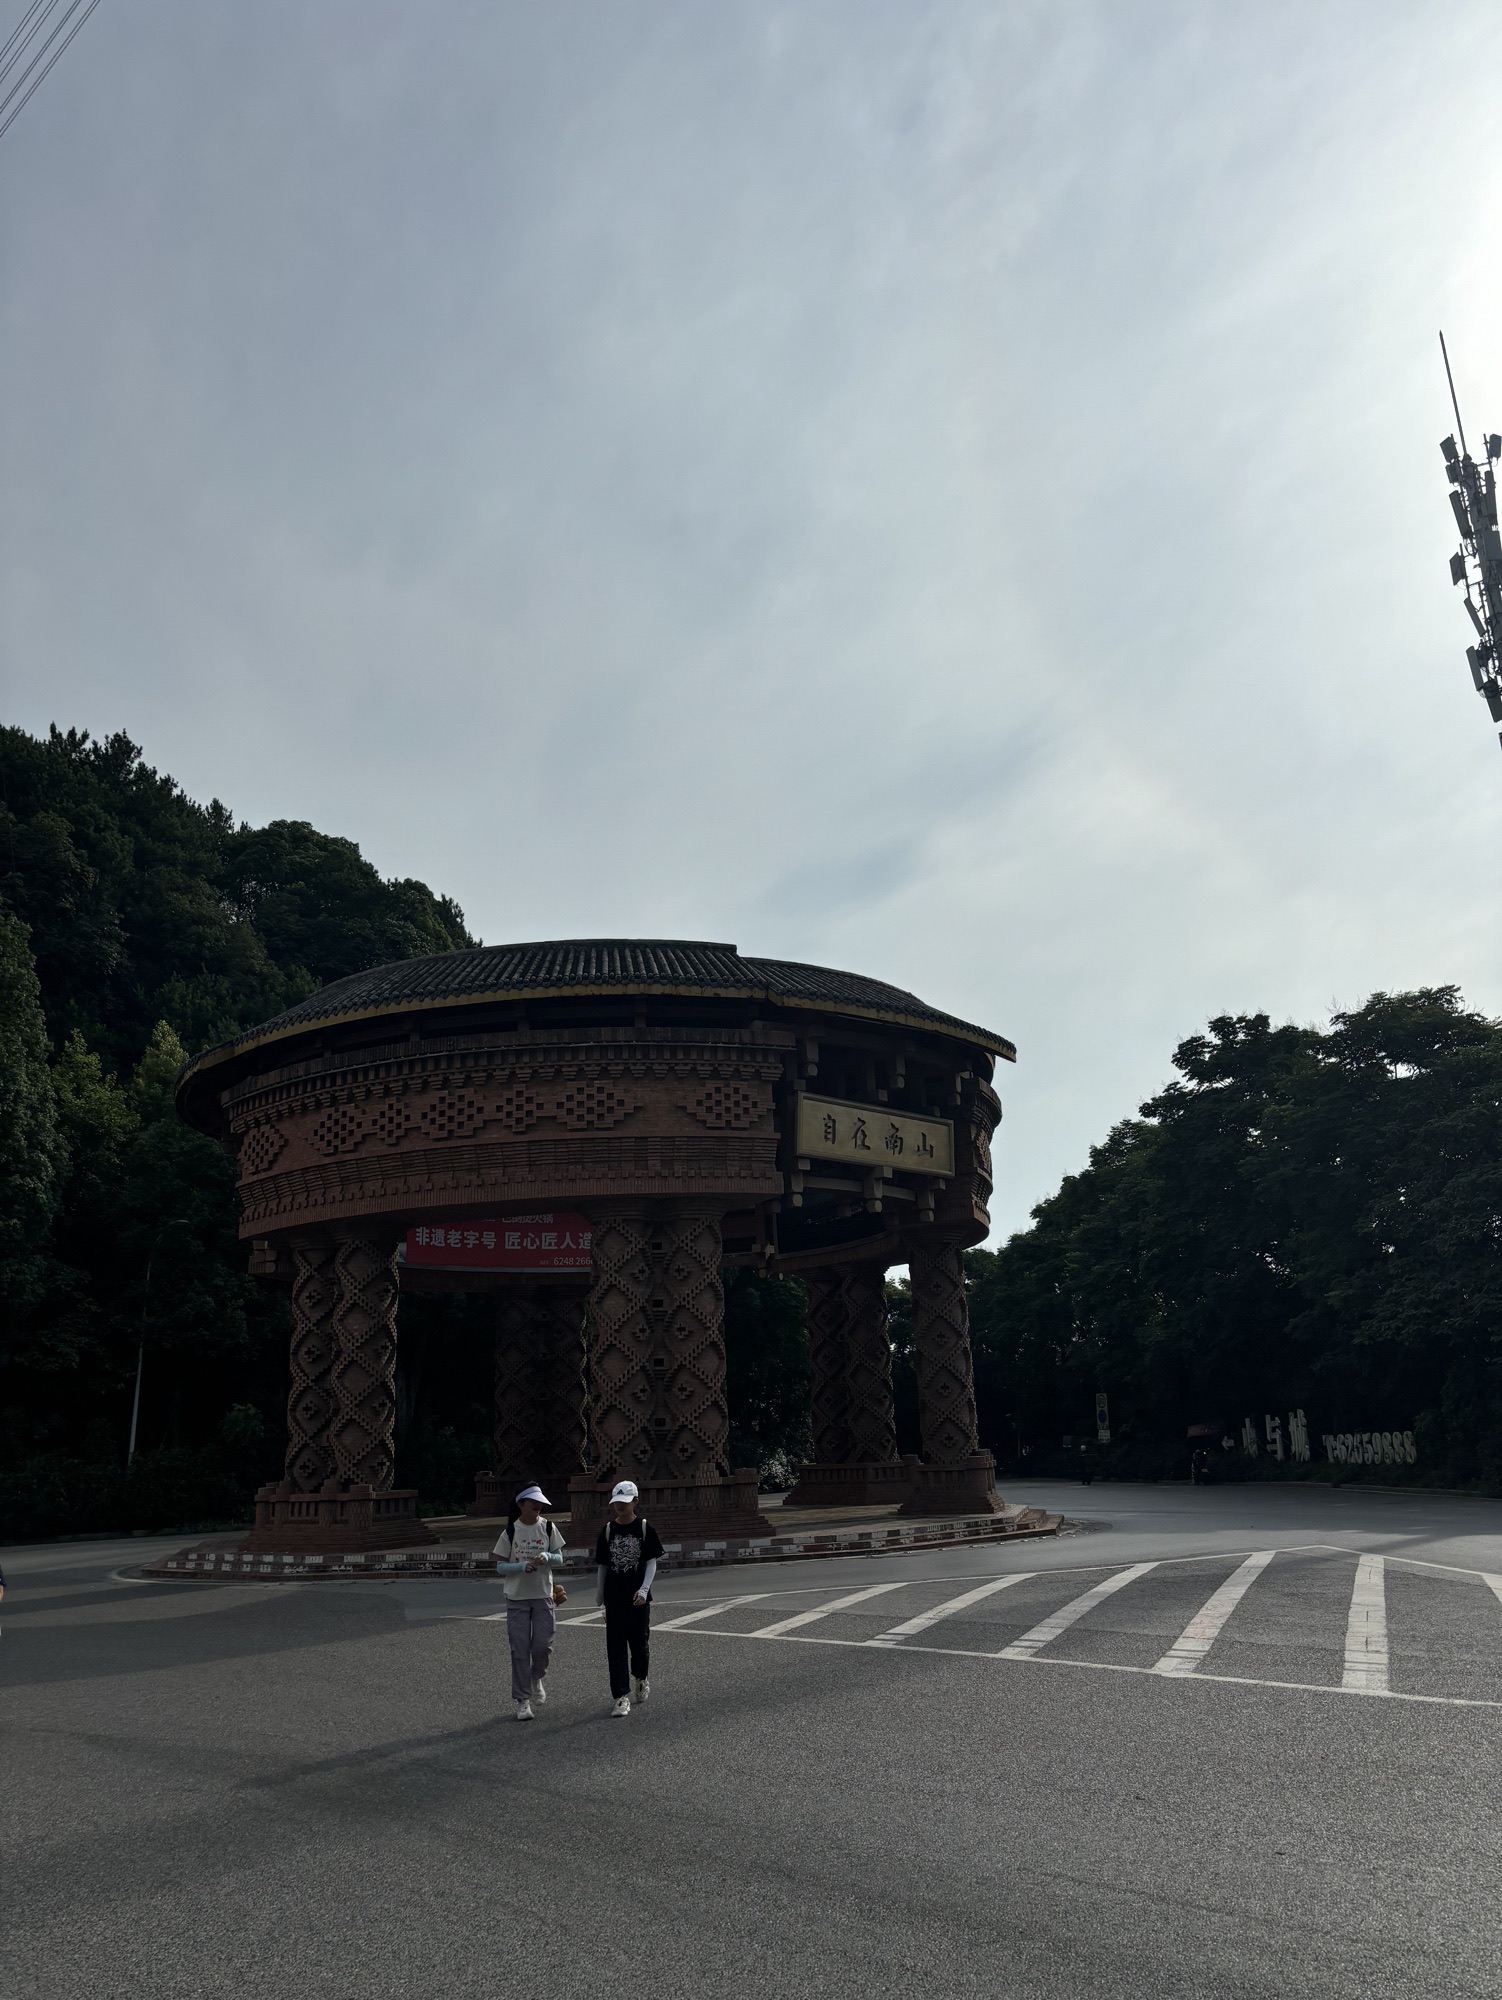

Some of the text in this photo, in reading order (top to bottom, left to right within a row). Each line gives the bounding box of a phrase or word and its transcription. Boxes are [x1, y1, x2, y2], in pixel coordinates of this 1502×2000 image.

[823, 1113, 934, 1159] 自在南山
[415, 1226, 497, 1250] 非遗老字号
[553, 1256, 574, 1266] 6248
[575, 1256, 593, 1266] 266
